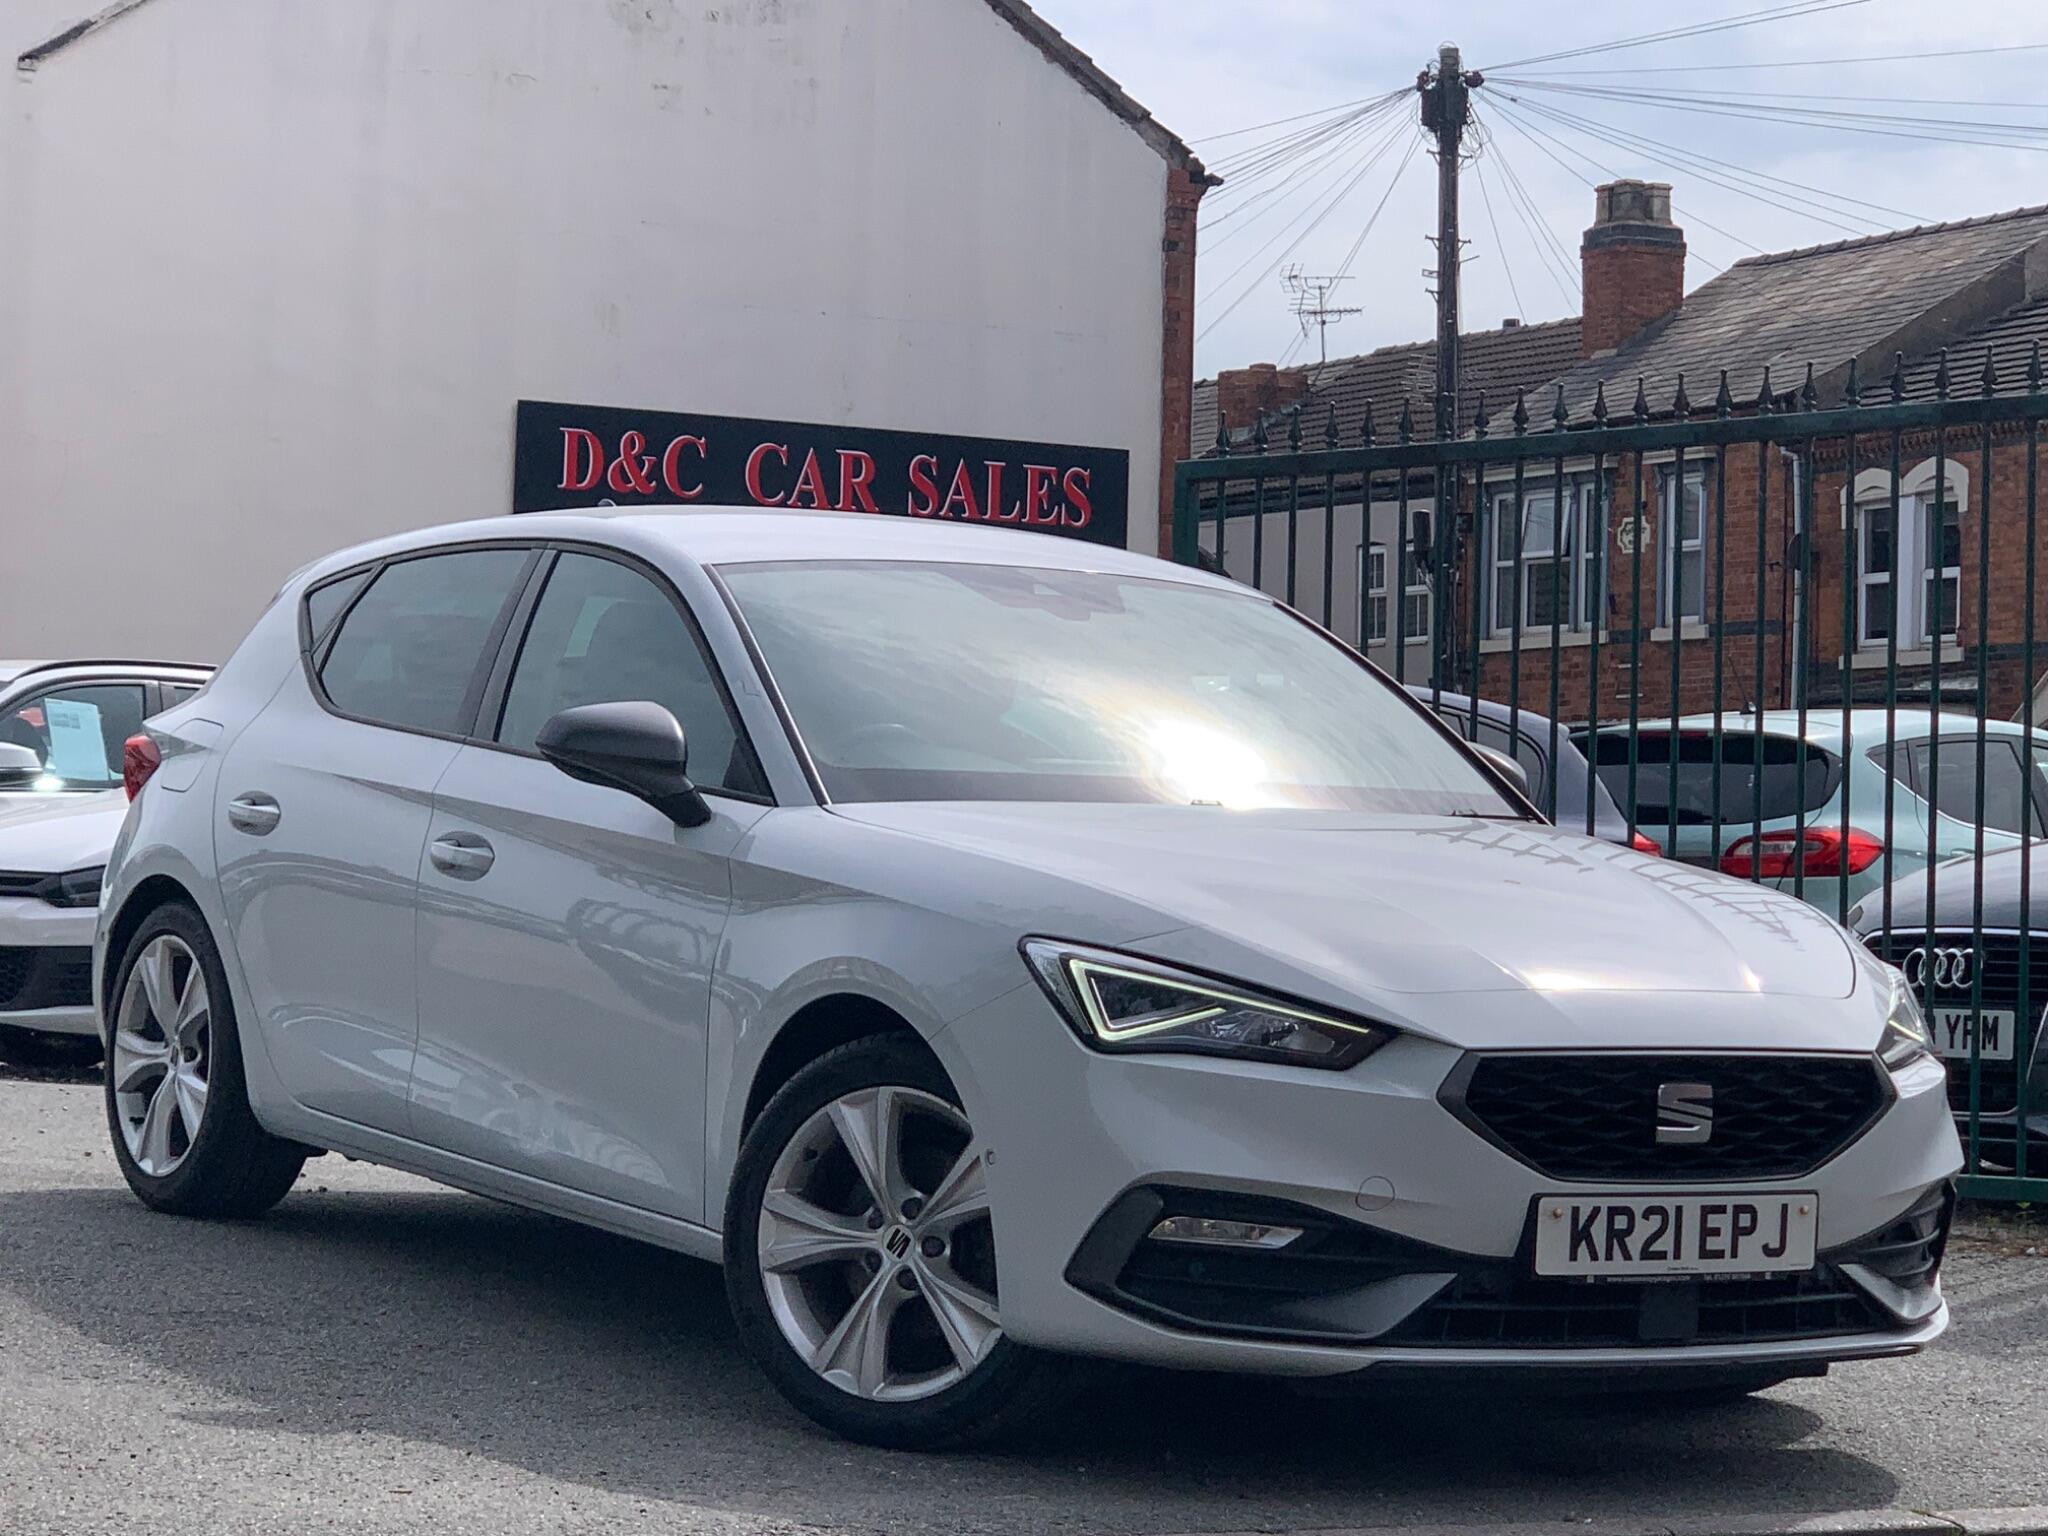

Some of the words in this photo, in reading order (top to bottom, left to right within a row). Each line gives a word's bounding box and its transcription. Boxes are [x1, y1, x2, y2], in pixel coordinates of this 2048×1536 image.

[558, 427, 706, 498] D&C
[744, 442, 880, 513] CAR
[907, 454, 1092, 529] SALES
[1568, 1205, 1684, 1262] KR21
[1698, 1203, 1789, 1260] EPJ
